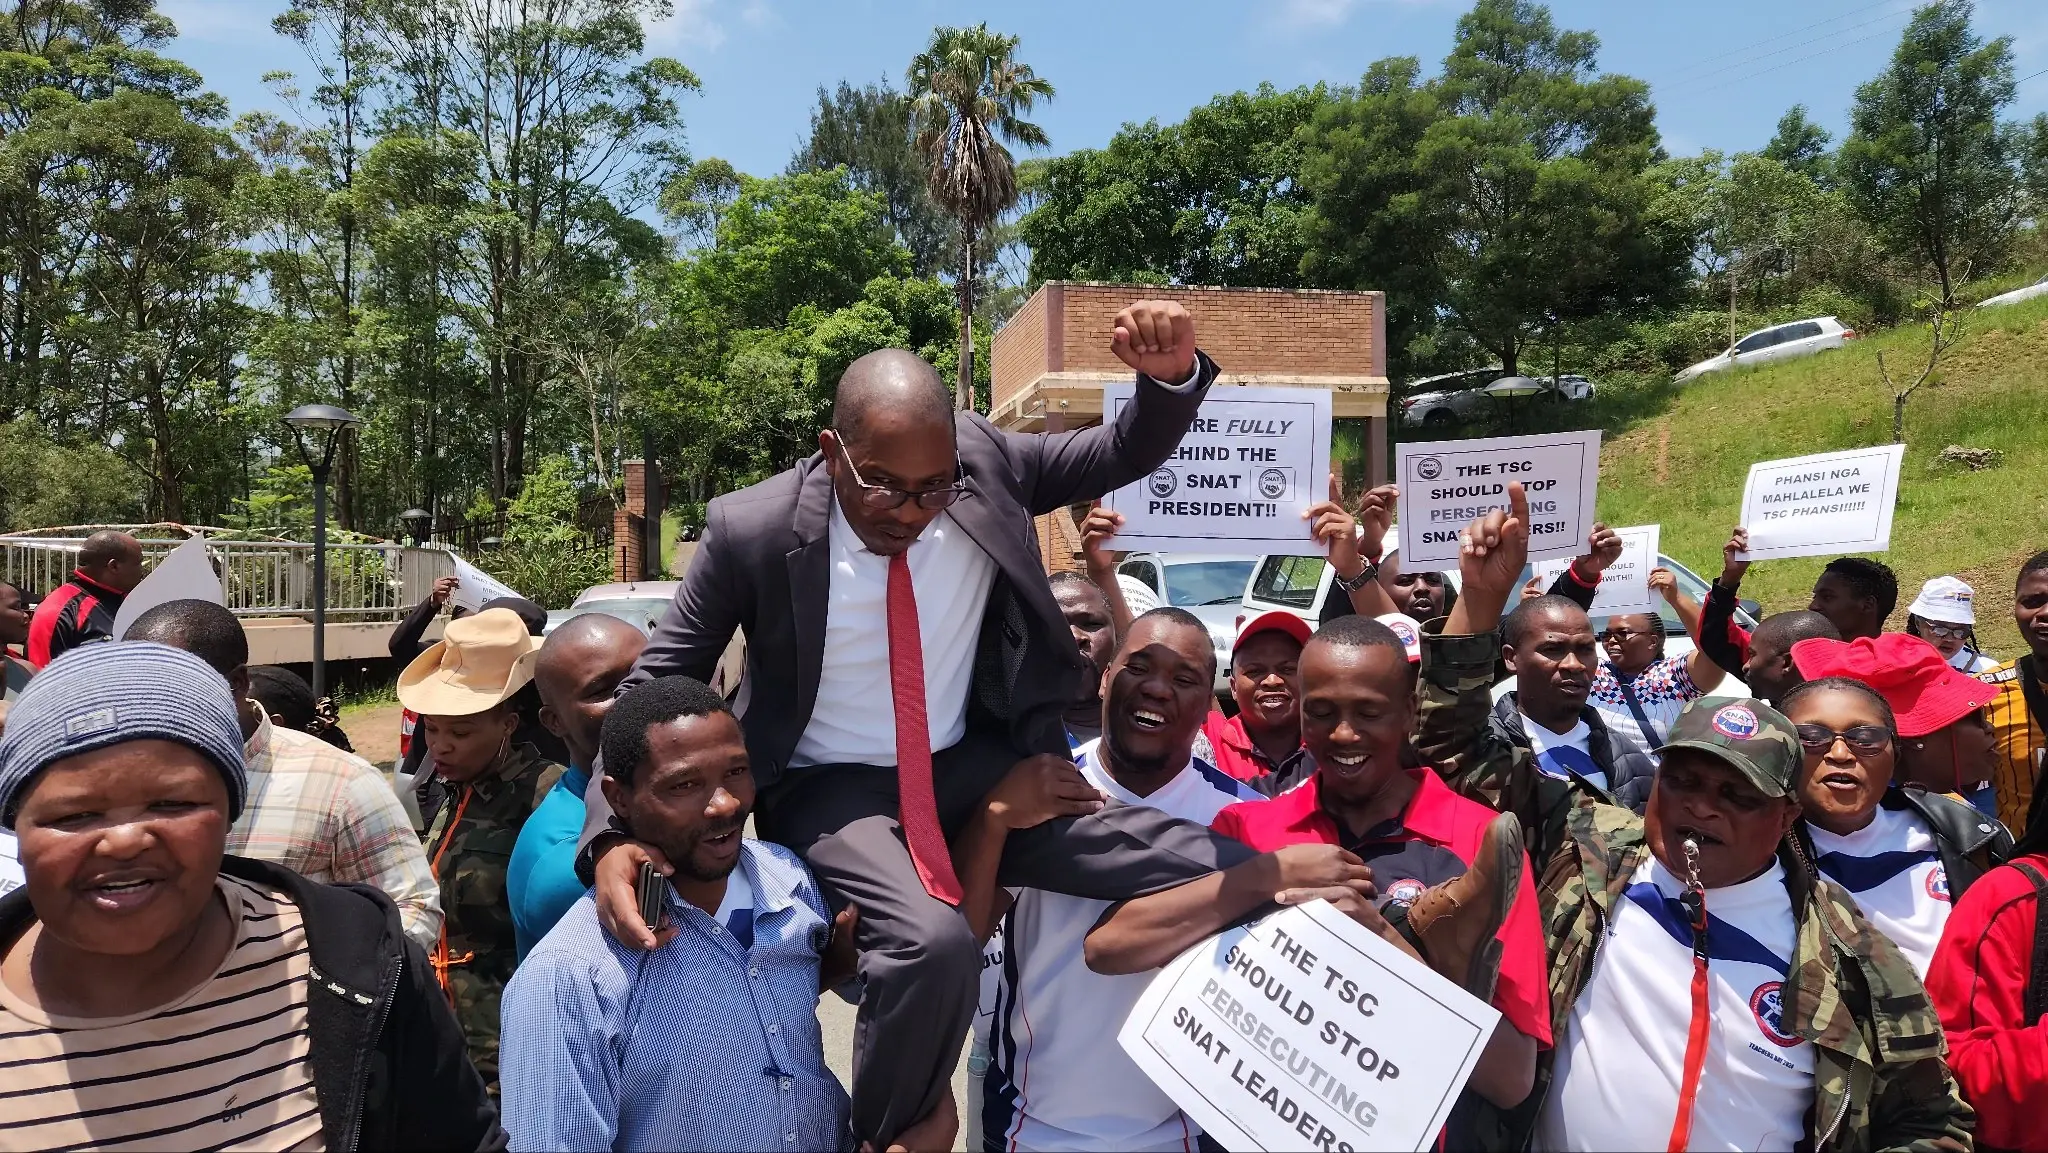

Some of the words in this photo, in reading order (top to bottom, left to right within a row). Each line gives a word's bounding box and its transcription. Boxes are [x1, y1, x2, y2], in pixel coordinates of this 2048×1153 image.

[1187, 418, 1219, 433] RE
[1226, 419, 1294, 435] FULLY
[1168, 446, 1230, 461] HIND
[1237, 447, 1277, 462] THE
[1455, 464, 1492, 478] THE
[1497, 460, 1533, 474] TSC
[1775, 472, 1826, 486] PHANSI
[1830, 467, 1861, 480] NGA
[1186, 474, 1241, 489] SNAT
[1431, 484, 1503, 499] SHOULD
[1520, 479, 1557, 492] TOP
[1762, 487, 1844, 504] MAHLALELA
[1848, 483, 1871, 494] WE
[1149, 501, 1277, 518] PRESIDENT!!
[1763, 509, 1787, 521] TSC
[1422, 529, 1462, 544] SNA
[1724, 711, 1751, 723] SNAT
[1269, 927, 1319, 976] THE
[1323, 965, 1380, 1017] TSC
[1224, 945, 1315, 1026] SHOULD
[1319, 1021, 1400, 1083] STOP
[1173, 1006, 1231, 1065] SNAT
[1201, 977, 1379, 1128] PERSECUTING
